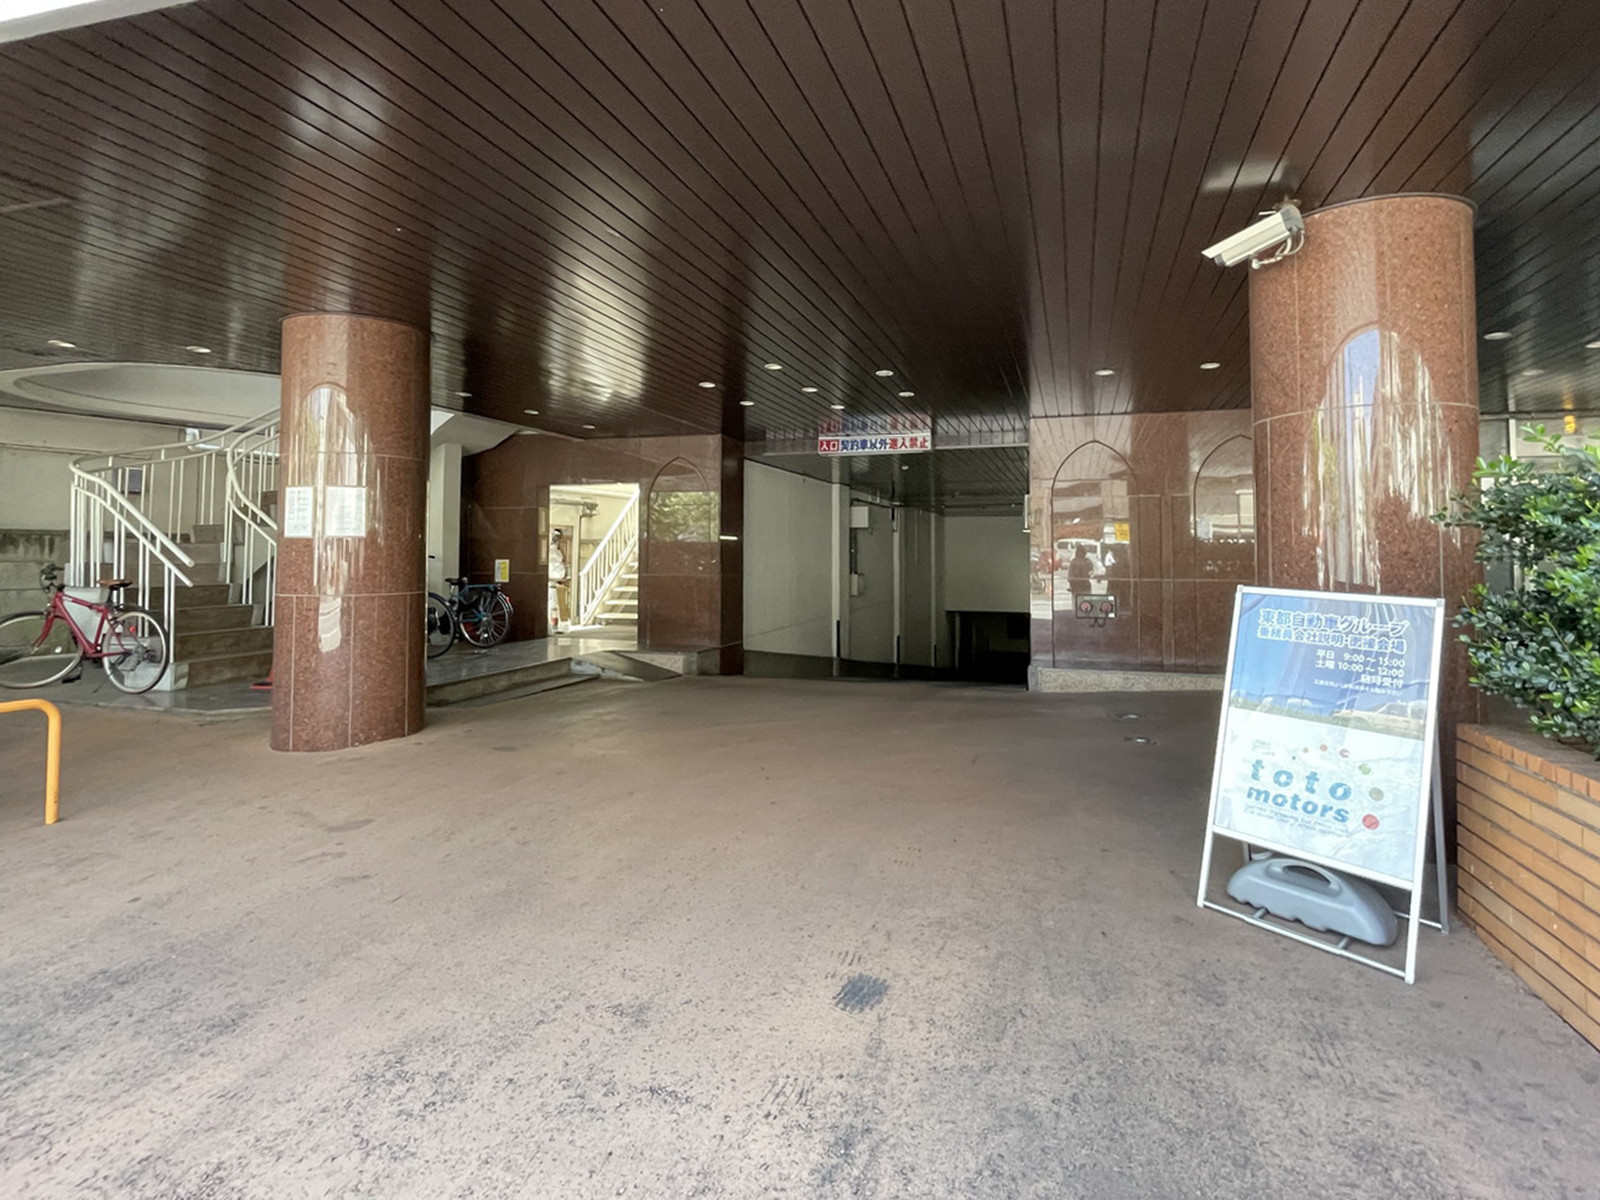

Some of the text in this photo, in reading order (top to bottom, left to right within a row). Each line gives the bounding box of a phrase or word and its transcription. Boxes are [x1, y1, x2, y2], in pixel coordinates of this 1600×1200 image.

[820, 440, 839, 451] 入口
[1258, 608, 1410, 637] 東都自動車グループ
[1316, 649, 1335, 660] 平日
[1315, 659, 1335, 670] 土曜
[1246, 787, 1350, 823] motors
